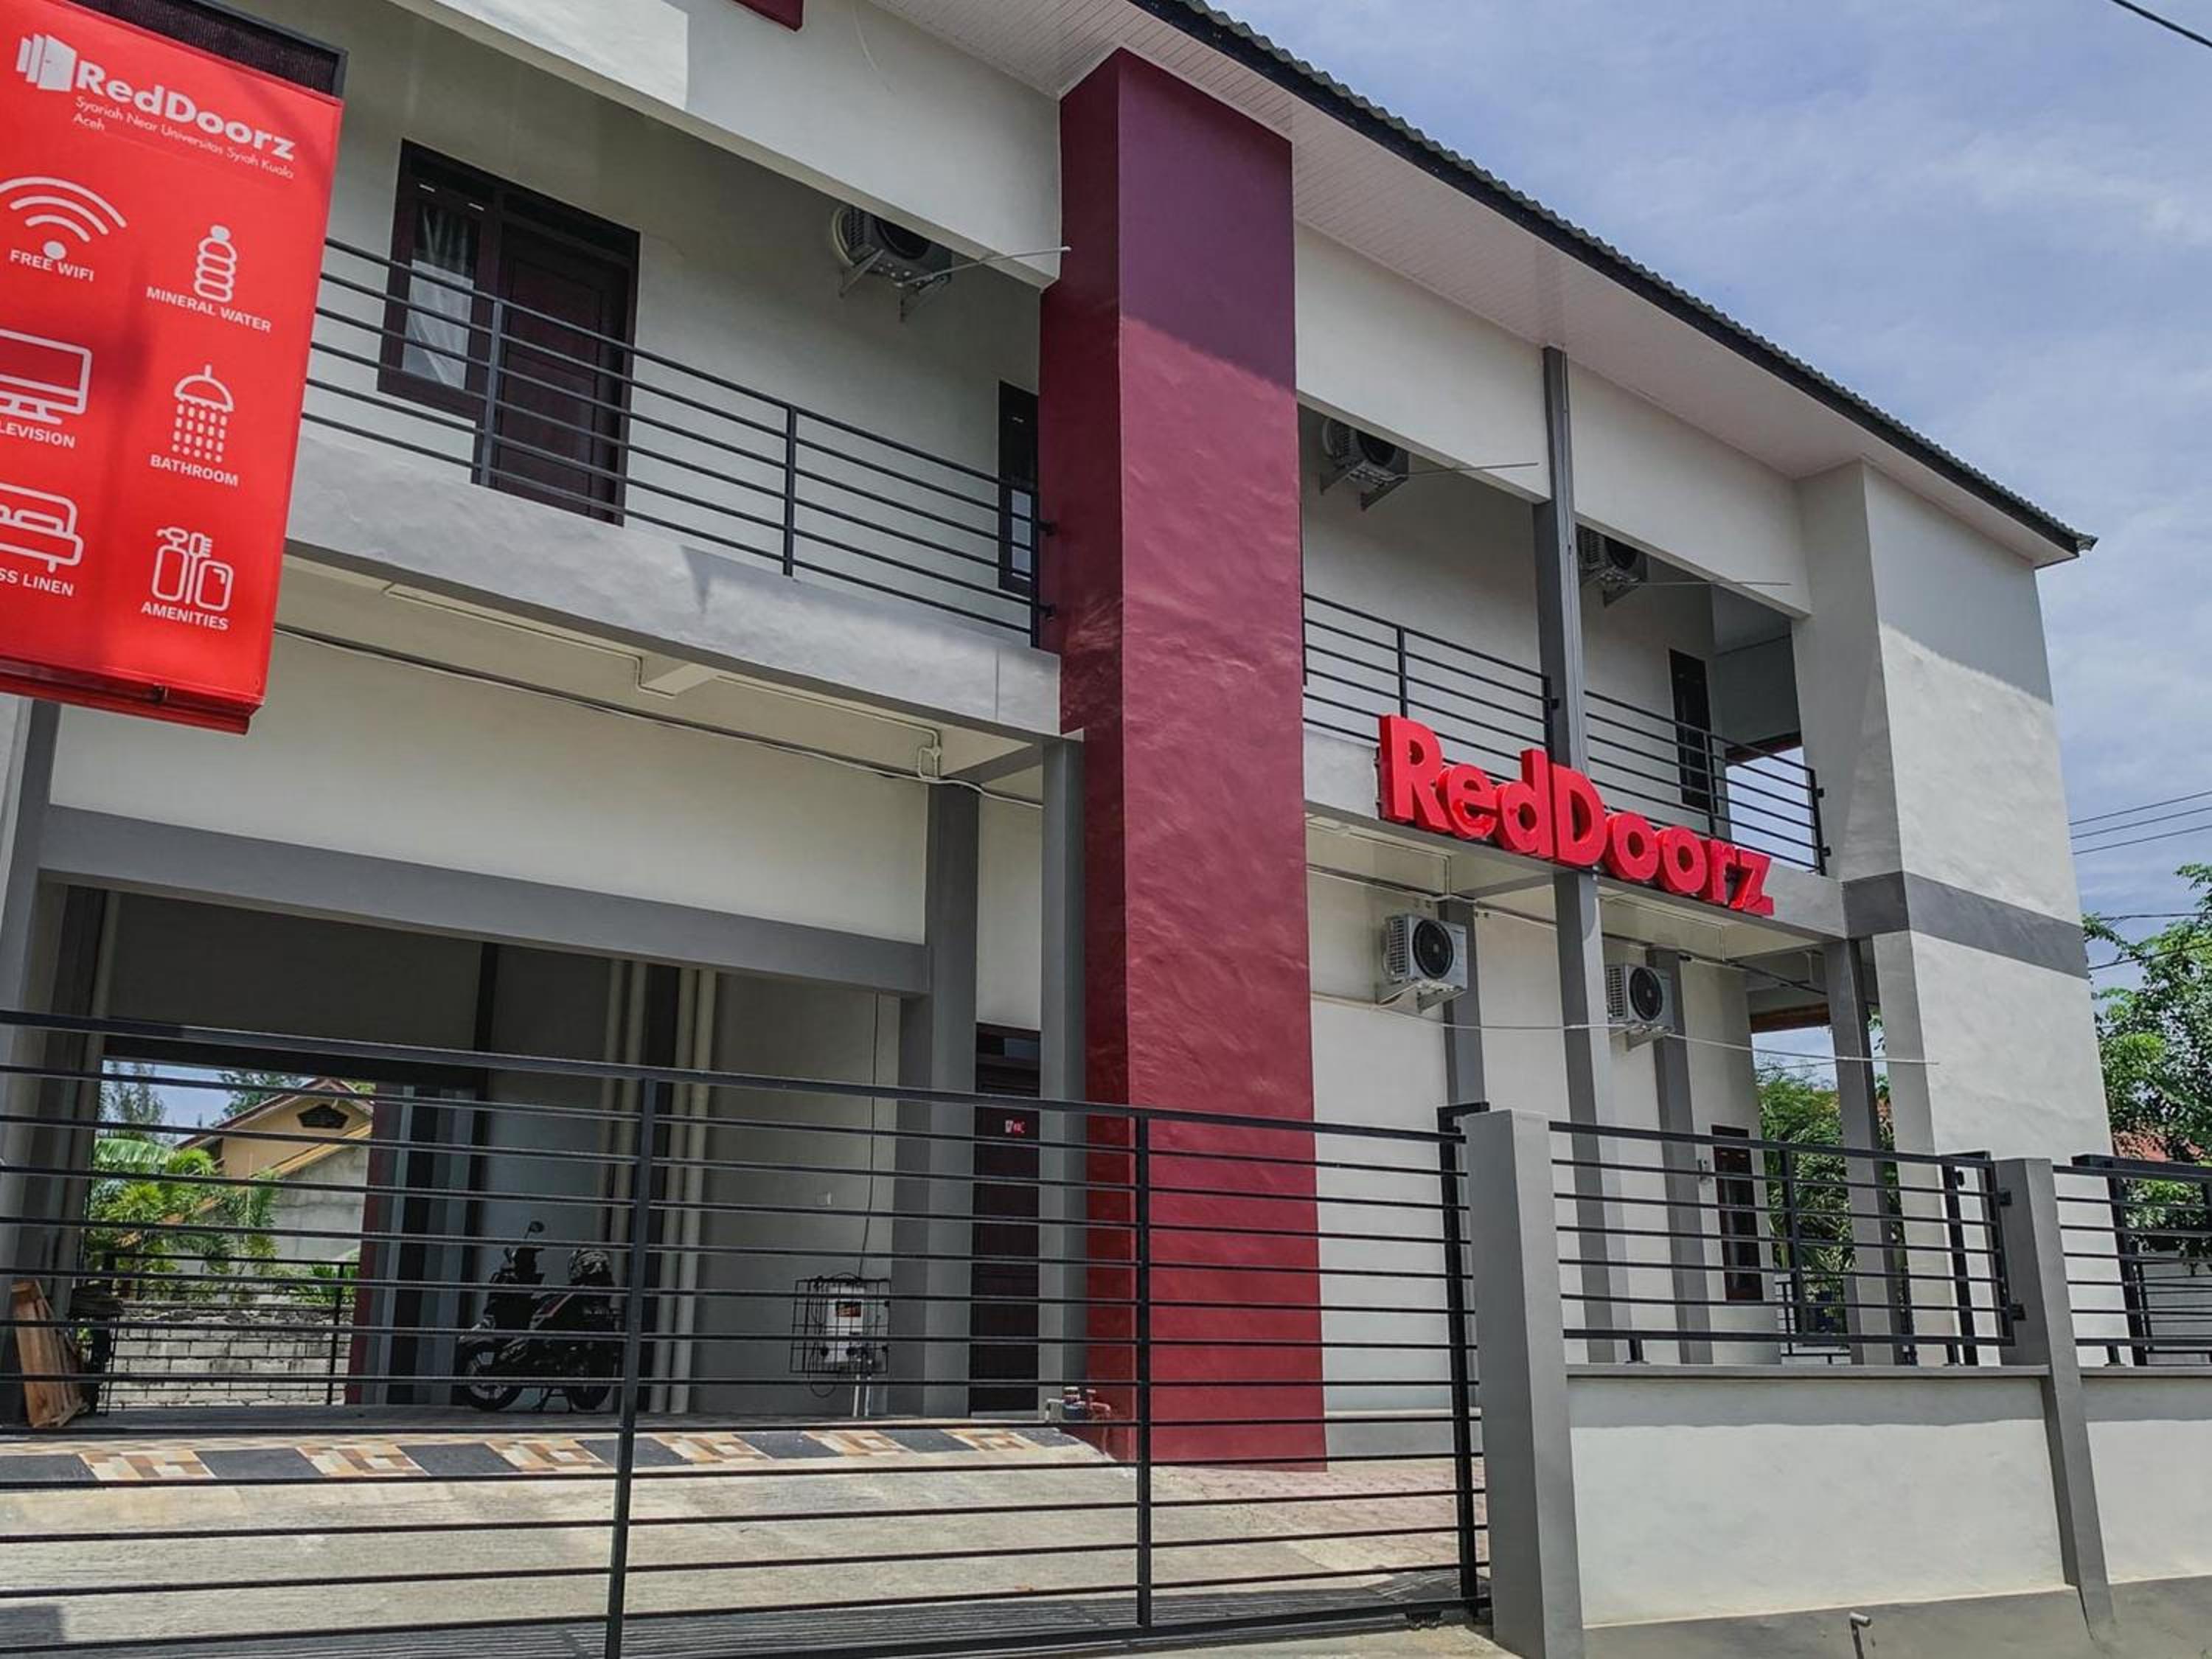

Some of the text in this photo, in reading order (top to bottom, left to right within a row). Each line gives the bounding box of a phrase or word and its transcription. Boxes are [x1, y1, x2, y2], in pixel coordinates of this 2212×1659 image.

[73, 113, 105, 131] Aceh
[76, 60, 296, 161] RedDoorz
[75, 96, 124, 121] Syariah
[126, 112, 158, 132] Near
[161, 124, 223, 155] Universitas
[261, 159, 294, 178] Kuala
[10, 249, 94, 282] FREE WIFI
[147, 286, 271, 333] MINERAL WATER
[150, 454, 238, 487] BATHROOM
[23, 573, 74, 597] LINEN
[141, 601, 229, 630] AMENITIES
[1378, 714, 1774, 917] RedDoorz
